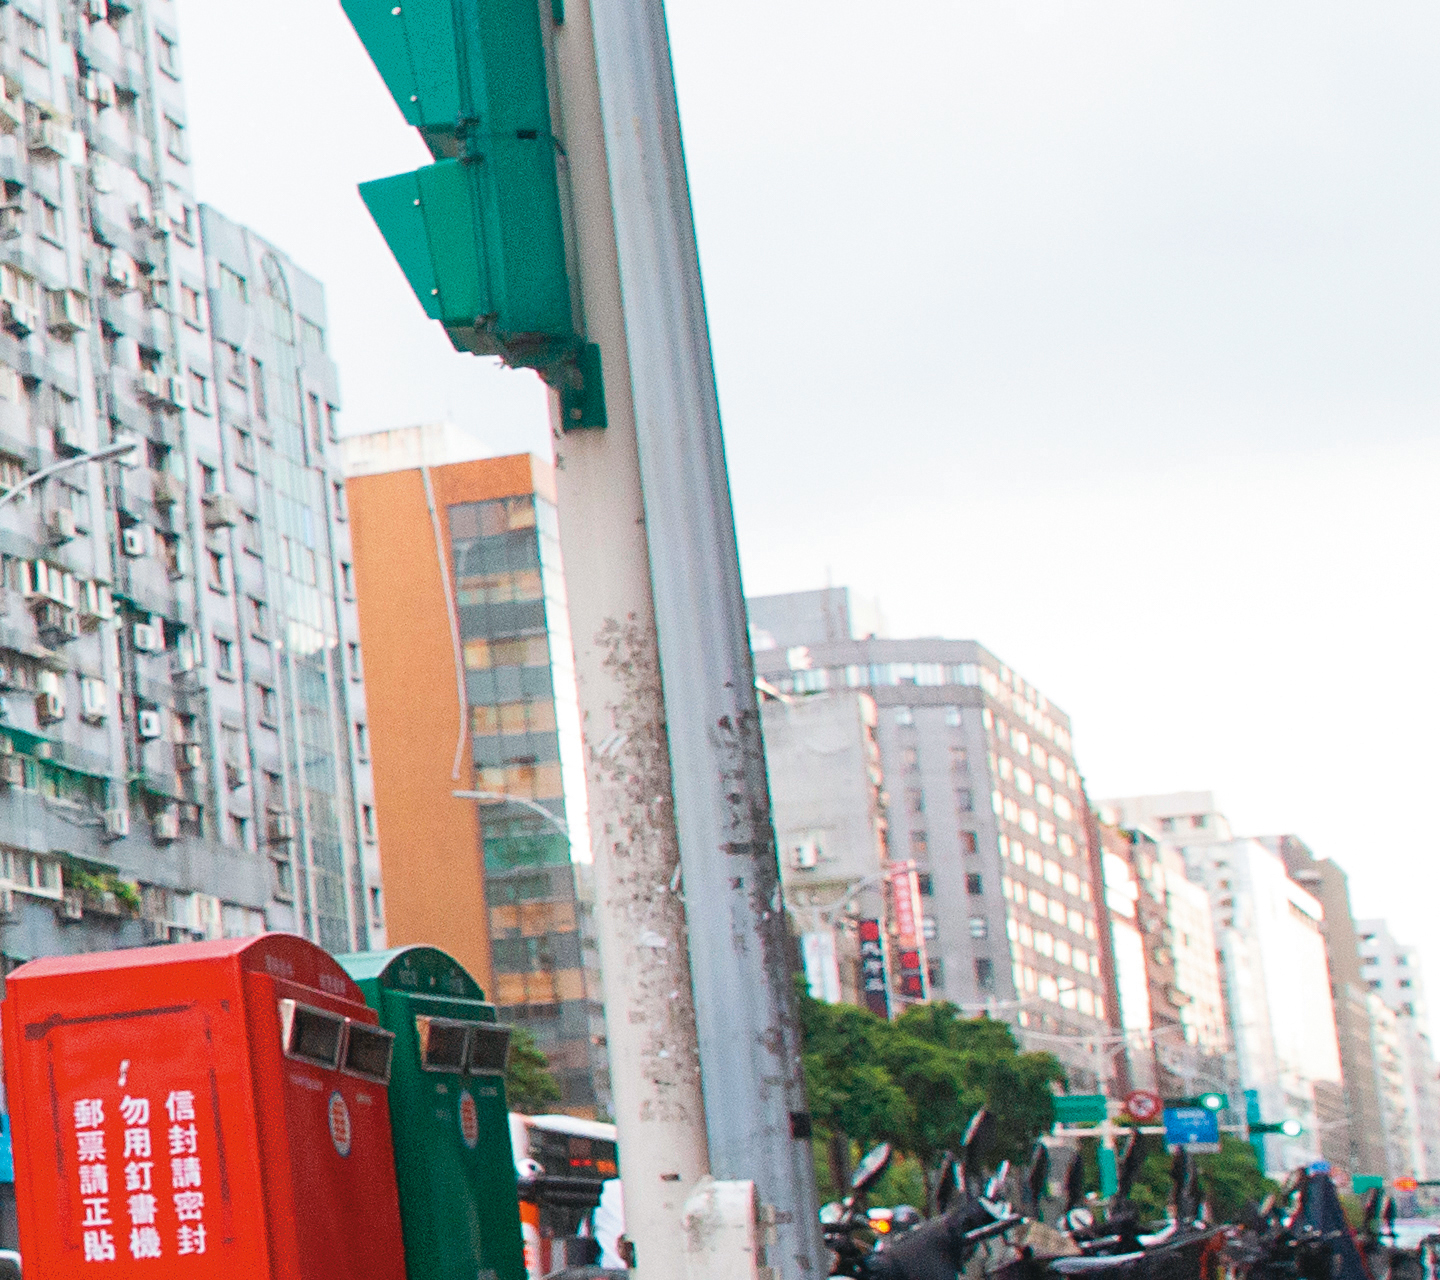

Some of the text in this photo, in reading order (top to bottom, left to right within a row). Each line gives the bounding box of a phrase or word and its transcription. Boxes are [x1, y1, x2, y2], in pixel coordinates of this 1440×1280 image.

[74, 1099, 117, 1262] 郵票請正貼
[118, 1060, 162, 1260] 勿用釘書機
[165, 1090, 207, 1255] 信封請密封
